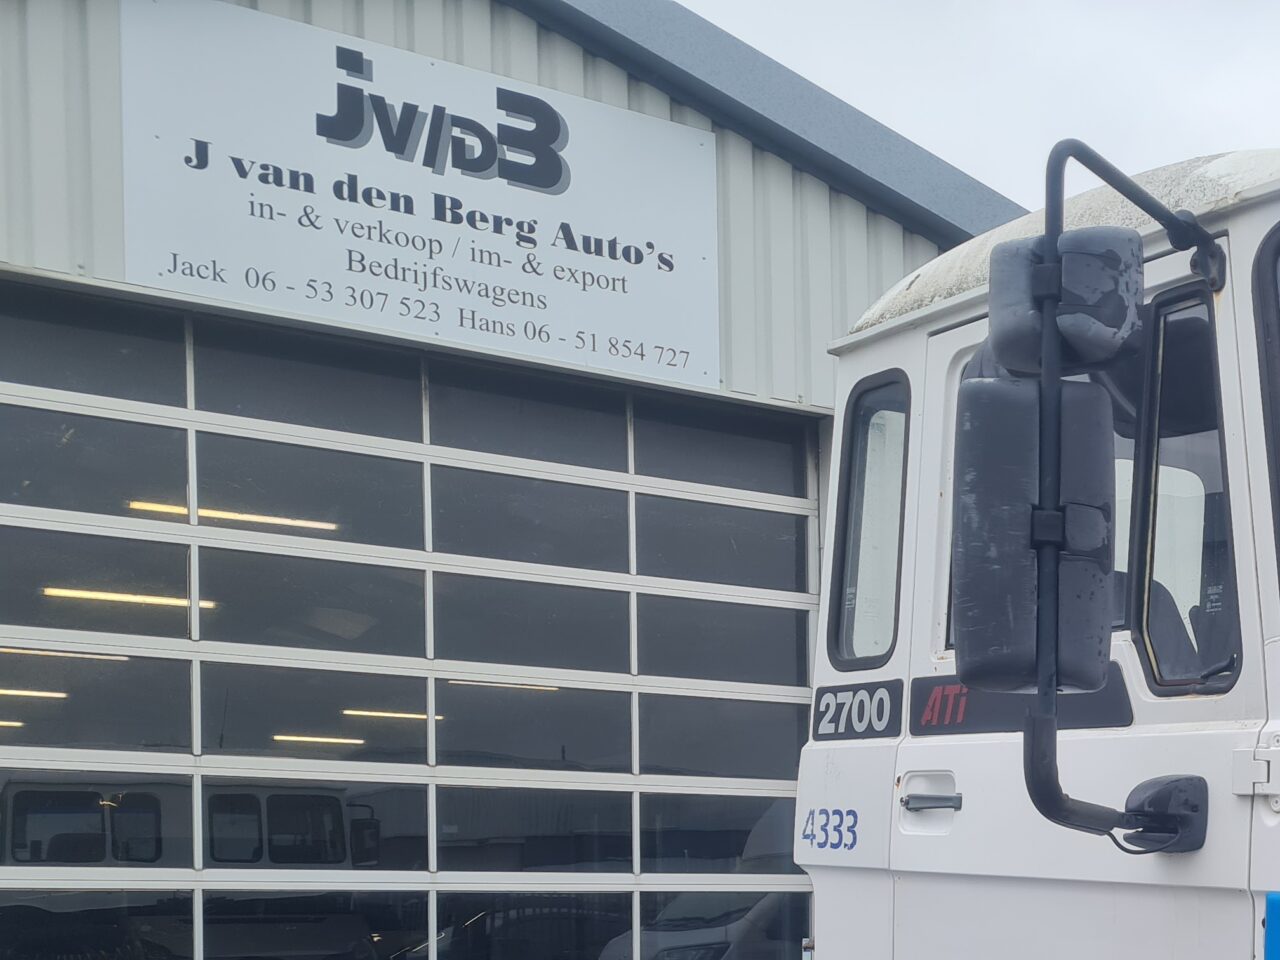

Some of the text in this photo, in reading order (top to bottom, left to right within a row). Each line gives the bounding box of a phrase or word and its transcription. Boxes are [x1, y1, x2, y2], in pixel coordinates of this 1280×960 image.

[184, 138, 675, 273] J van den Berg Auto's
[248, 193, 287, 221] in-
[298, 205, 323, 230] &
[333, 217, 443, 260] verkoop
[470, 240, 512, 267] im-
[522, 253, 544, 276] &
[553, 264, 628, 293] export
[167, 252, 228, 284] Jack
[245, 267, 276, 292] 06
[305, 279, 333, 302] 53
[345, 286, 389, 313] 307
[399, 297, 441, 322] 523
[459, 307, 516, 337] Hans
[524, 321, 550, 343] 06
[575, 331, 598, 352] 51
[608, 337, 646, 361] 854
[654, 345, 690, 369] 727
[346, 249, 547, 309] Bedrijfswagens
[817, 684, 968, 735] 2700 ATi
[801, 808, 857, 850] 4333
